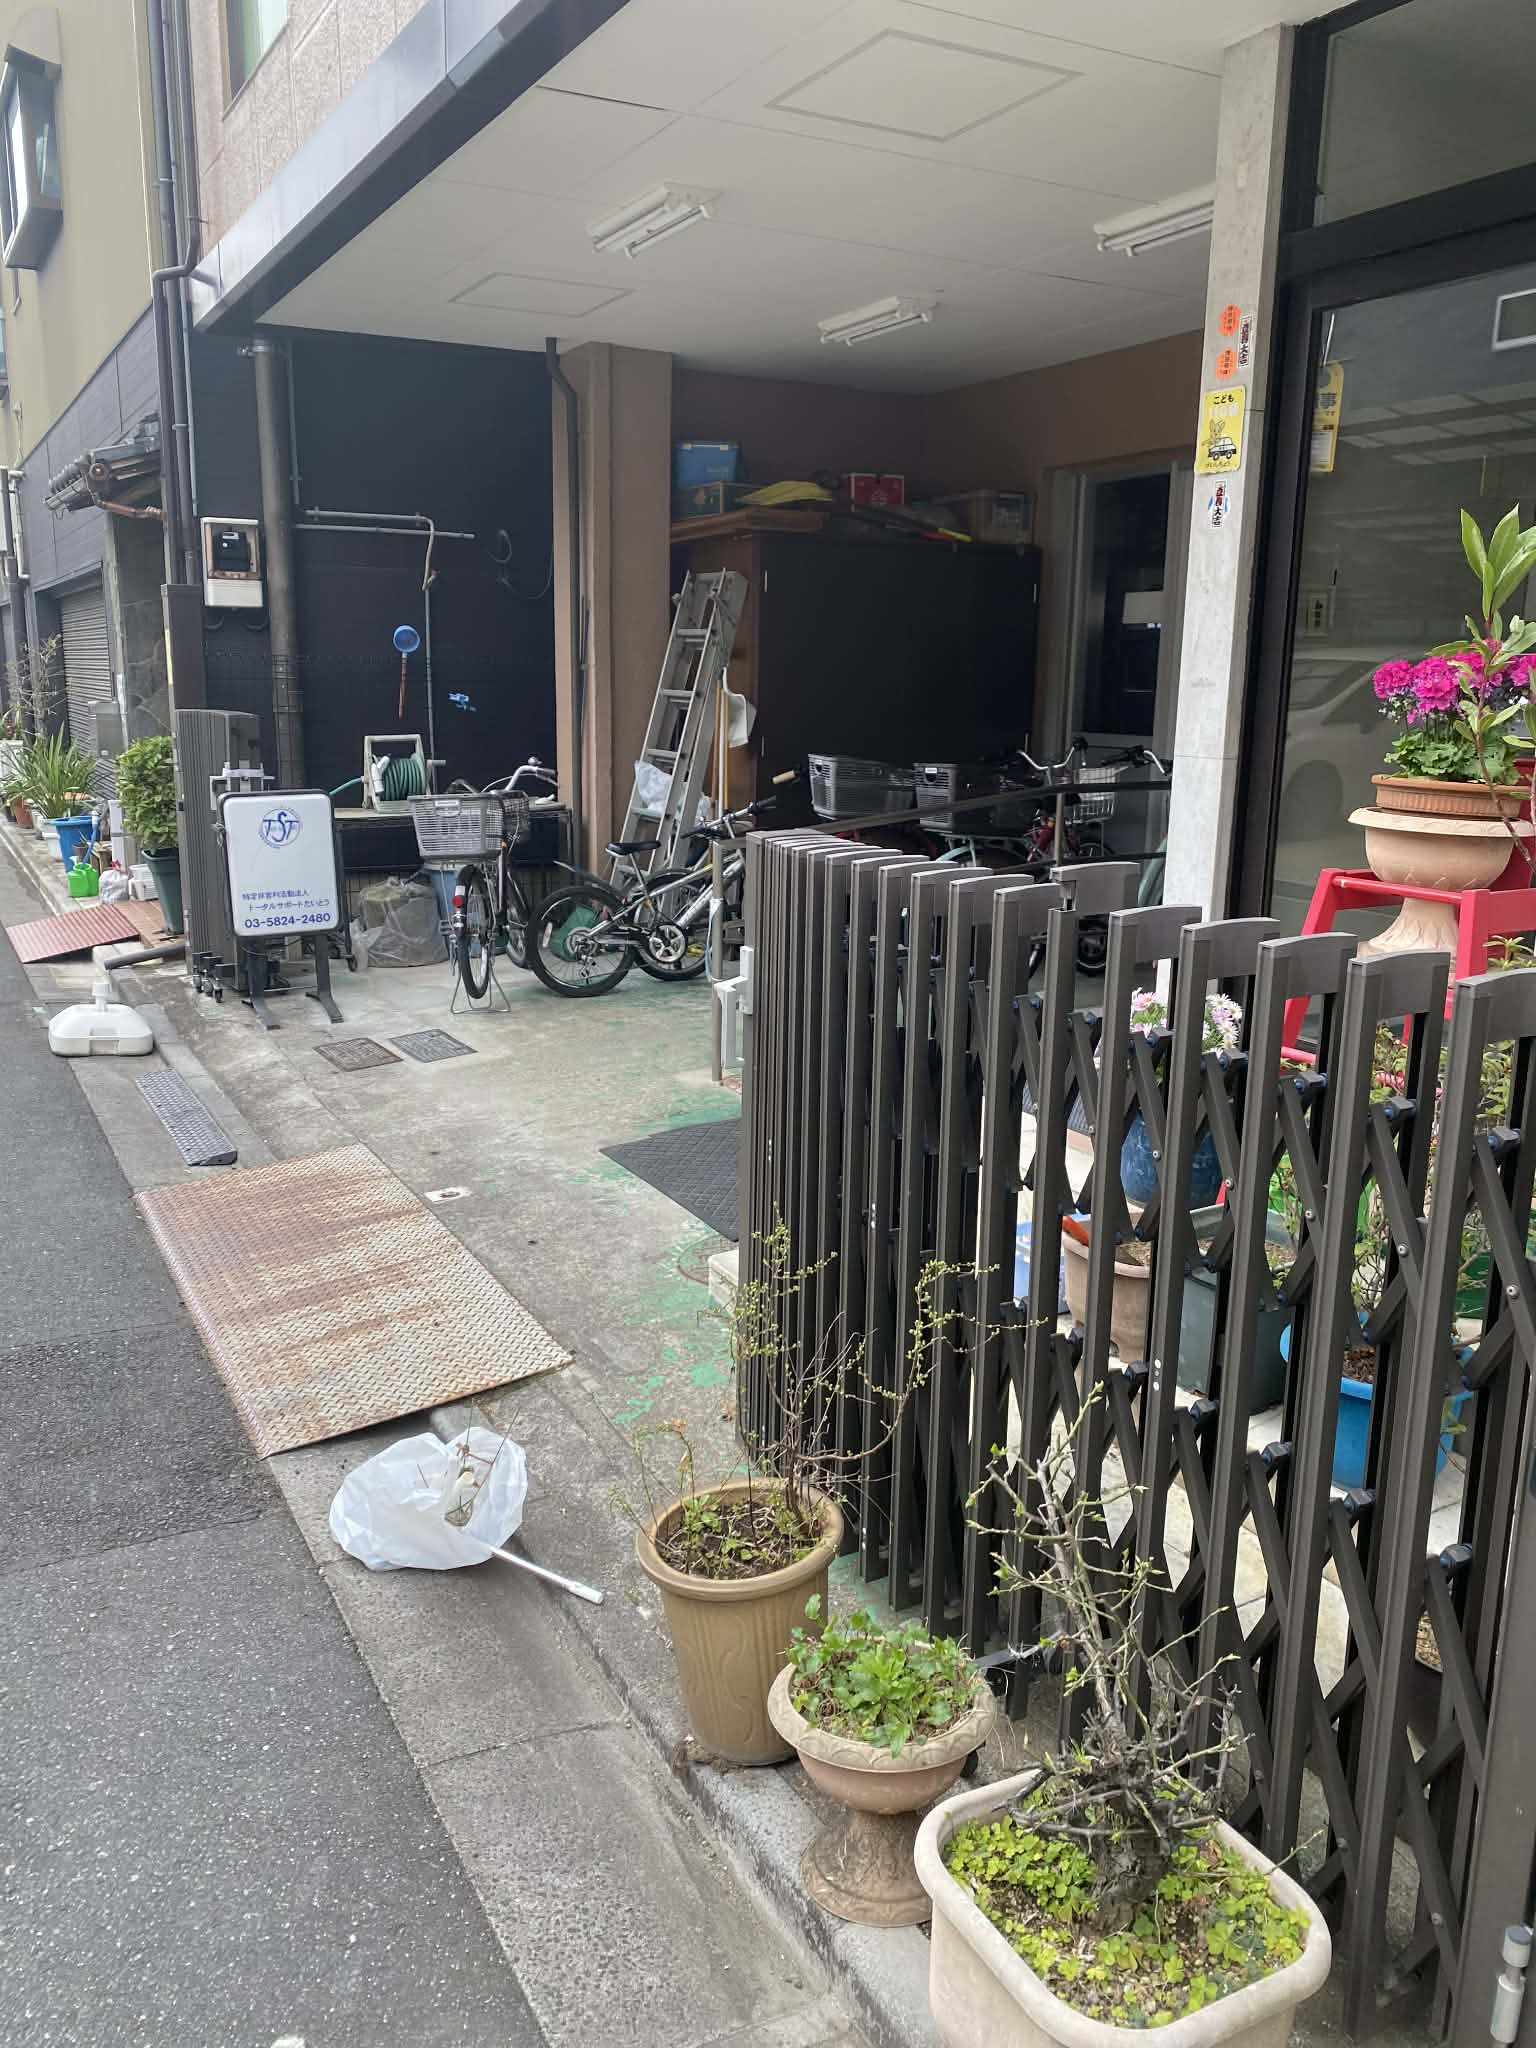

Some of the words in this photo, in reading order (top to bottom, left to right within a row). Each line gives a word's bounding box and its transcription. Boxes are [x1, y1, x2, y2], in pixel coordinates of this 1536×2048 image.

[1213, 394, 1234, 405] こども
[249, 899, 330, 911] トータルサポートたいとう
[244, 913, 331, 928] 03-5824-2480
